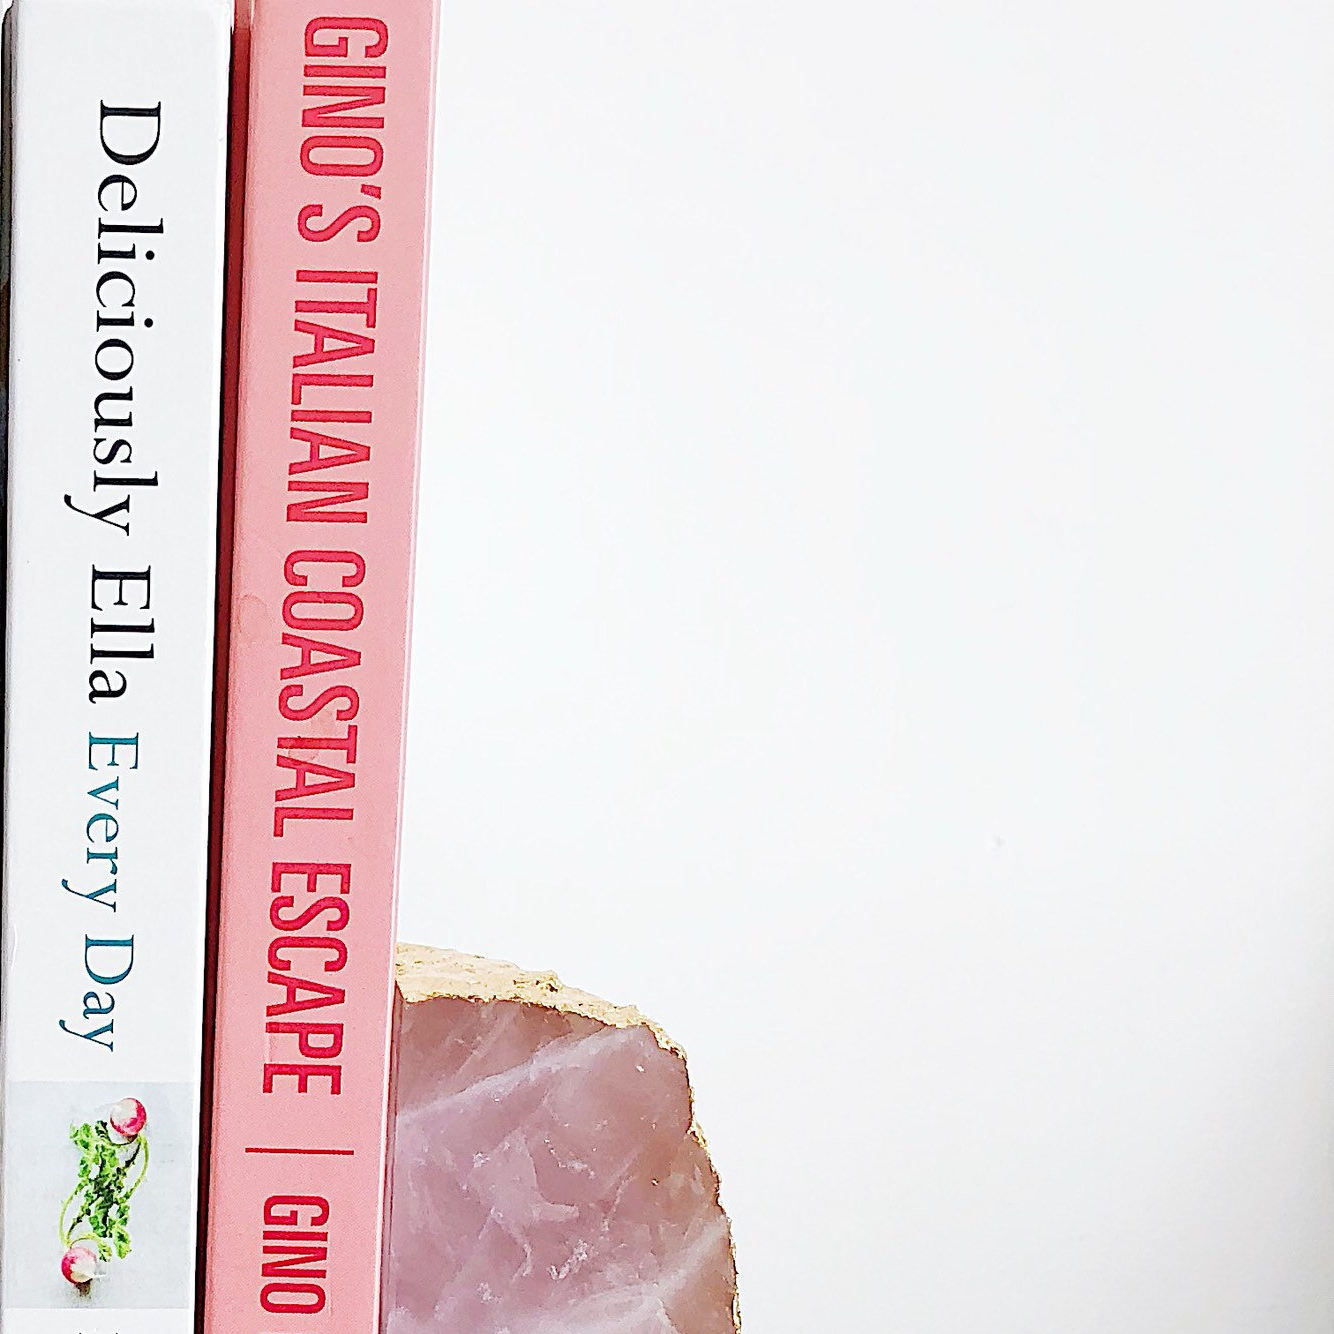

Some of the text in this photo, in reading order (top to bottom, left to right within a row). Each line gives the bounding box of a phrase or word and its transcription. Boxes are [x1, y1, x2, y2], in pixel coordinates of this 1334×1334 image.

[59, 100, 163, 1052] Deliciously Ella Every Day
[263, 17, 388, 1095] GINO'S ITALIAN COASTAL ESCAPE
[260, 1196, 329, 1314] GINO
